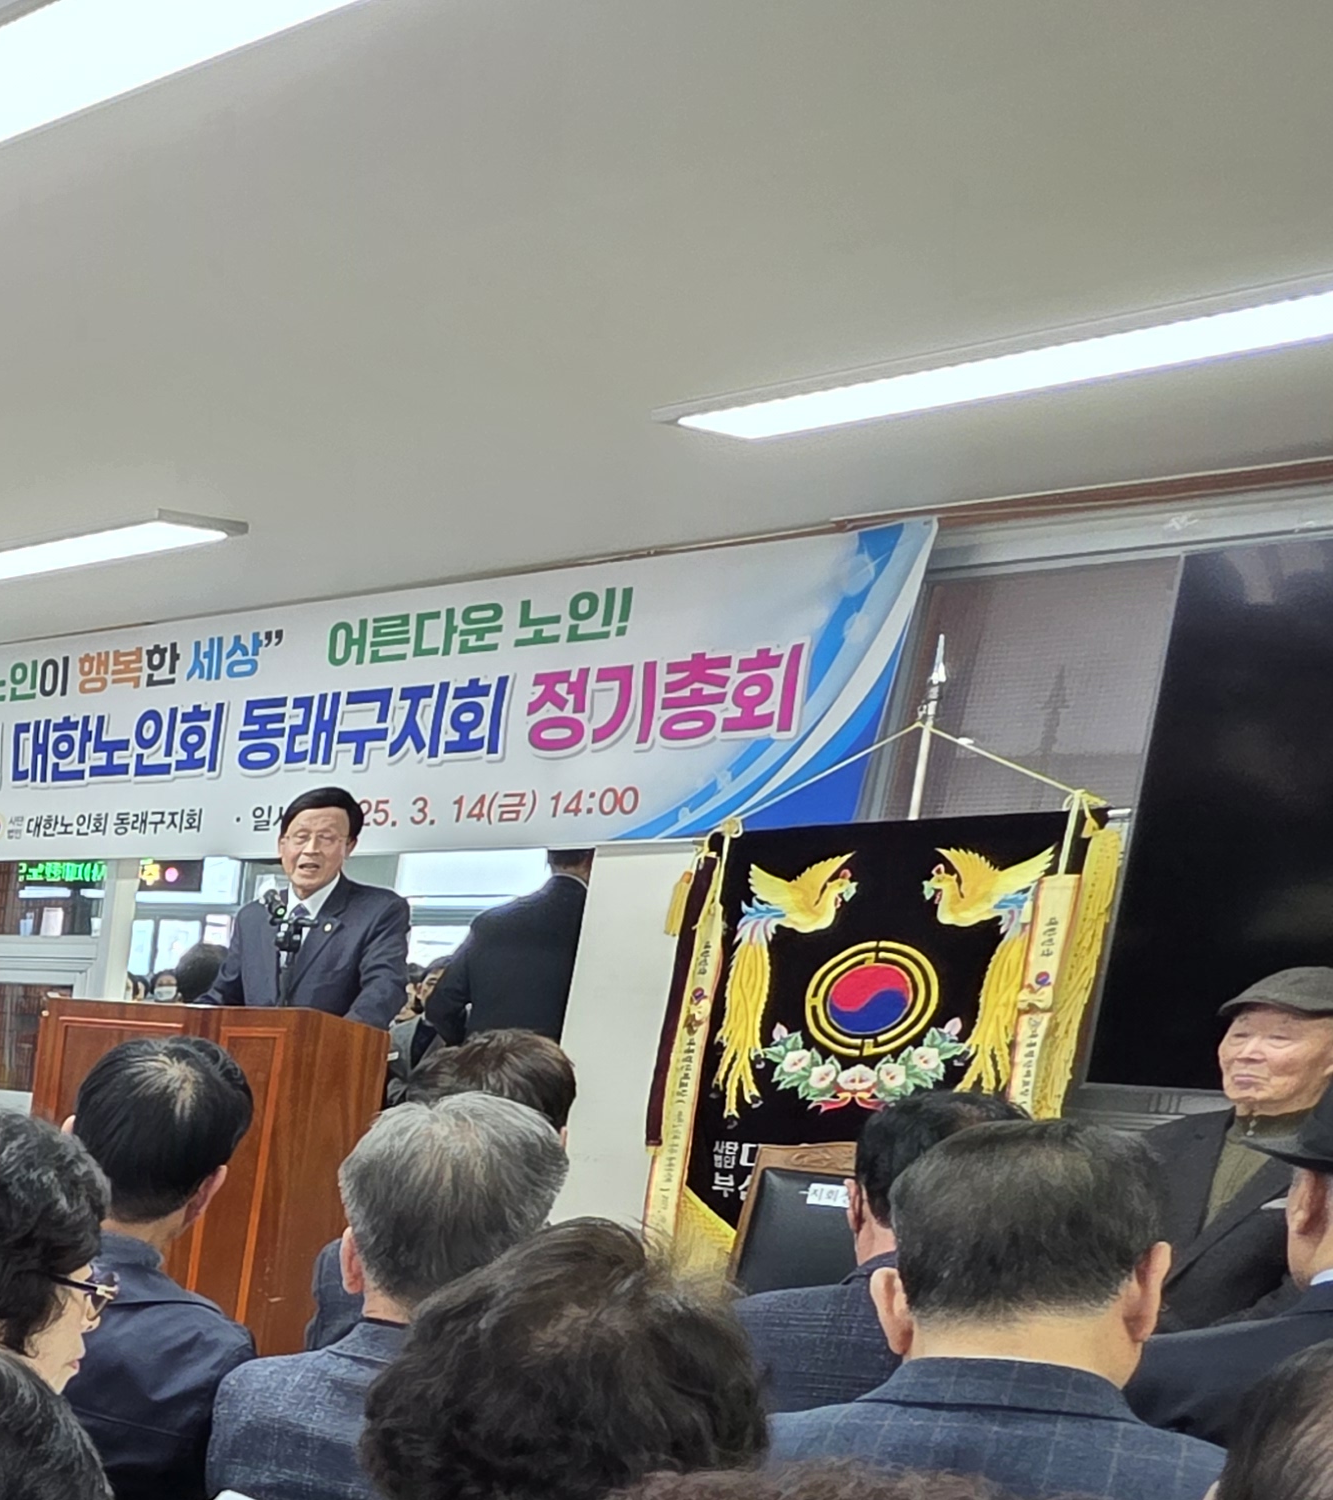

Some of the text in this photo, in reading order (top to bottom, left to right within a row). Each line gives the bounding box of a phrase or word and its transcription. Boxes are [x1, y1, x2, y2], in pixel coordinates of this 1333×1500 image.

[77, 641, 180, 695] 행복한
[327, 601, 504, 668] 어른다운
[514, 586, 634, 647] 노인!
[11, 701, 225, 785] 대한노인회
[237, 675, 511, 771] 동래구지회
[527, 642, 805, 753] 정기총회
[25, 807, 204, 838] 대한노인회 동래구지회
[409, 796, 436, 825] 3.
[452, 789, 536, 825] 14(금)
[549, 785, 640, 819] 14:00
[713, 1140, 739, 1155] 사단
[713, 1154, 736, 1169] 법인
